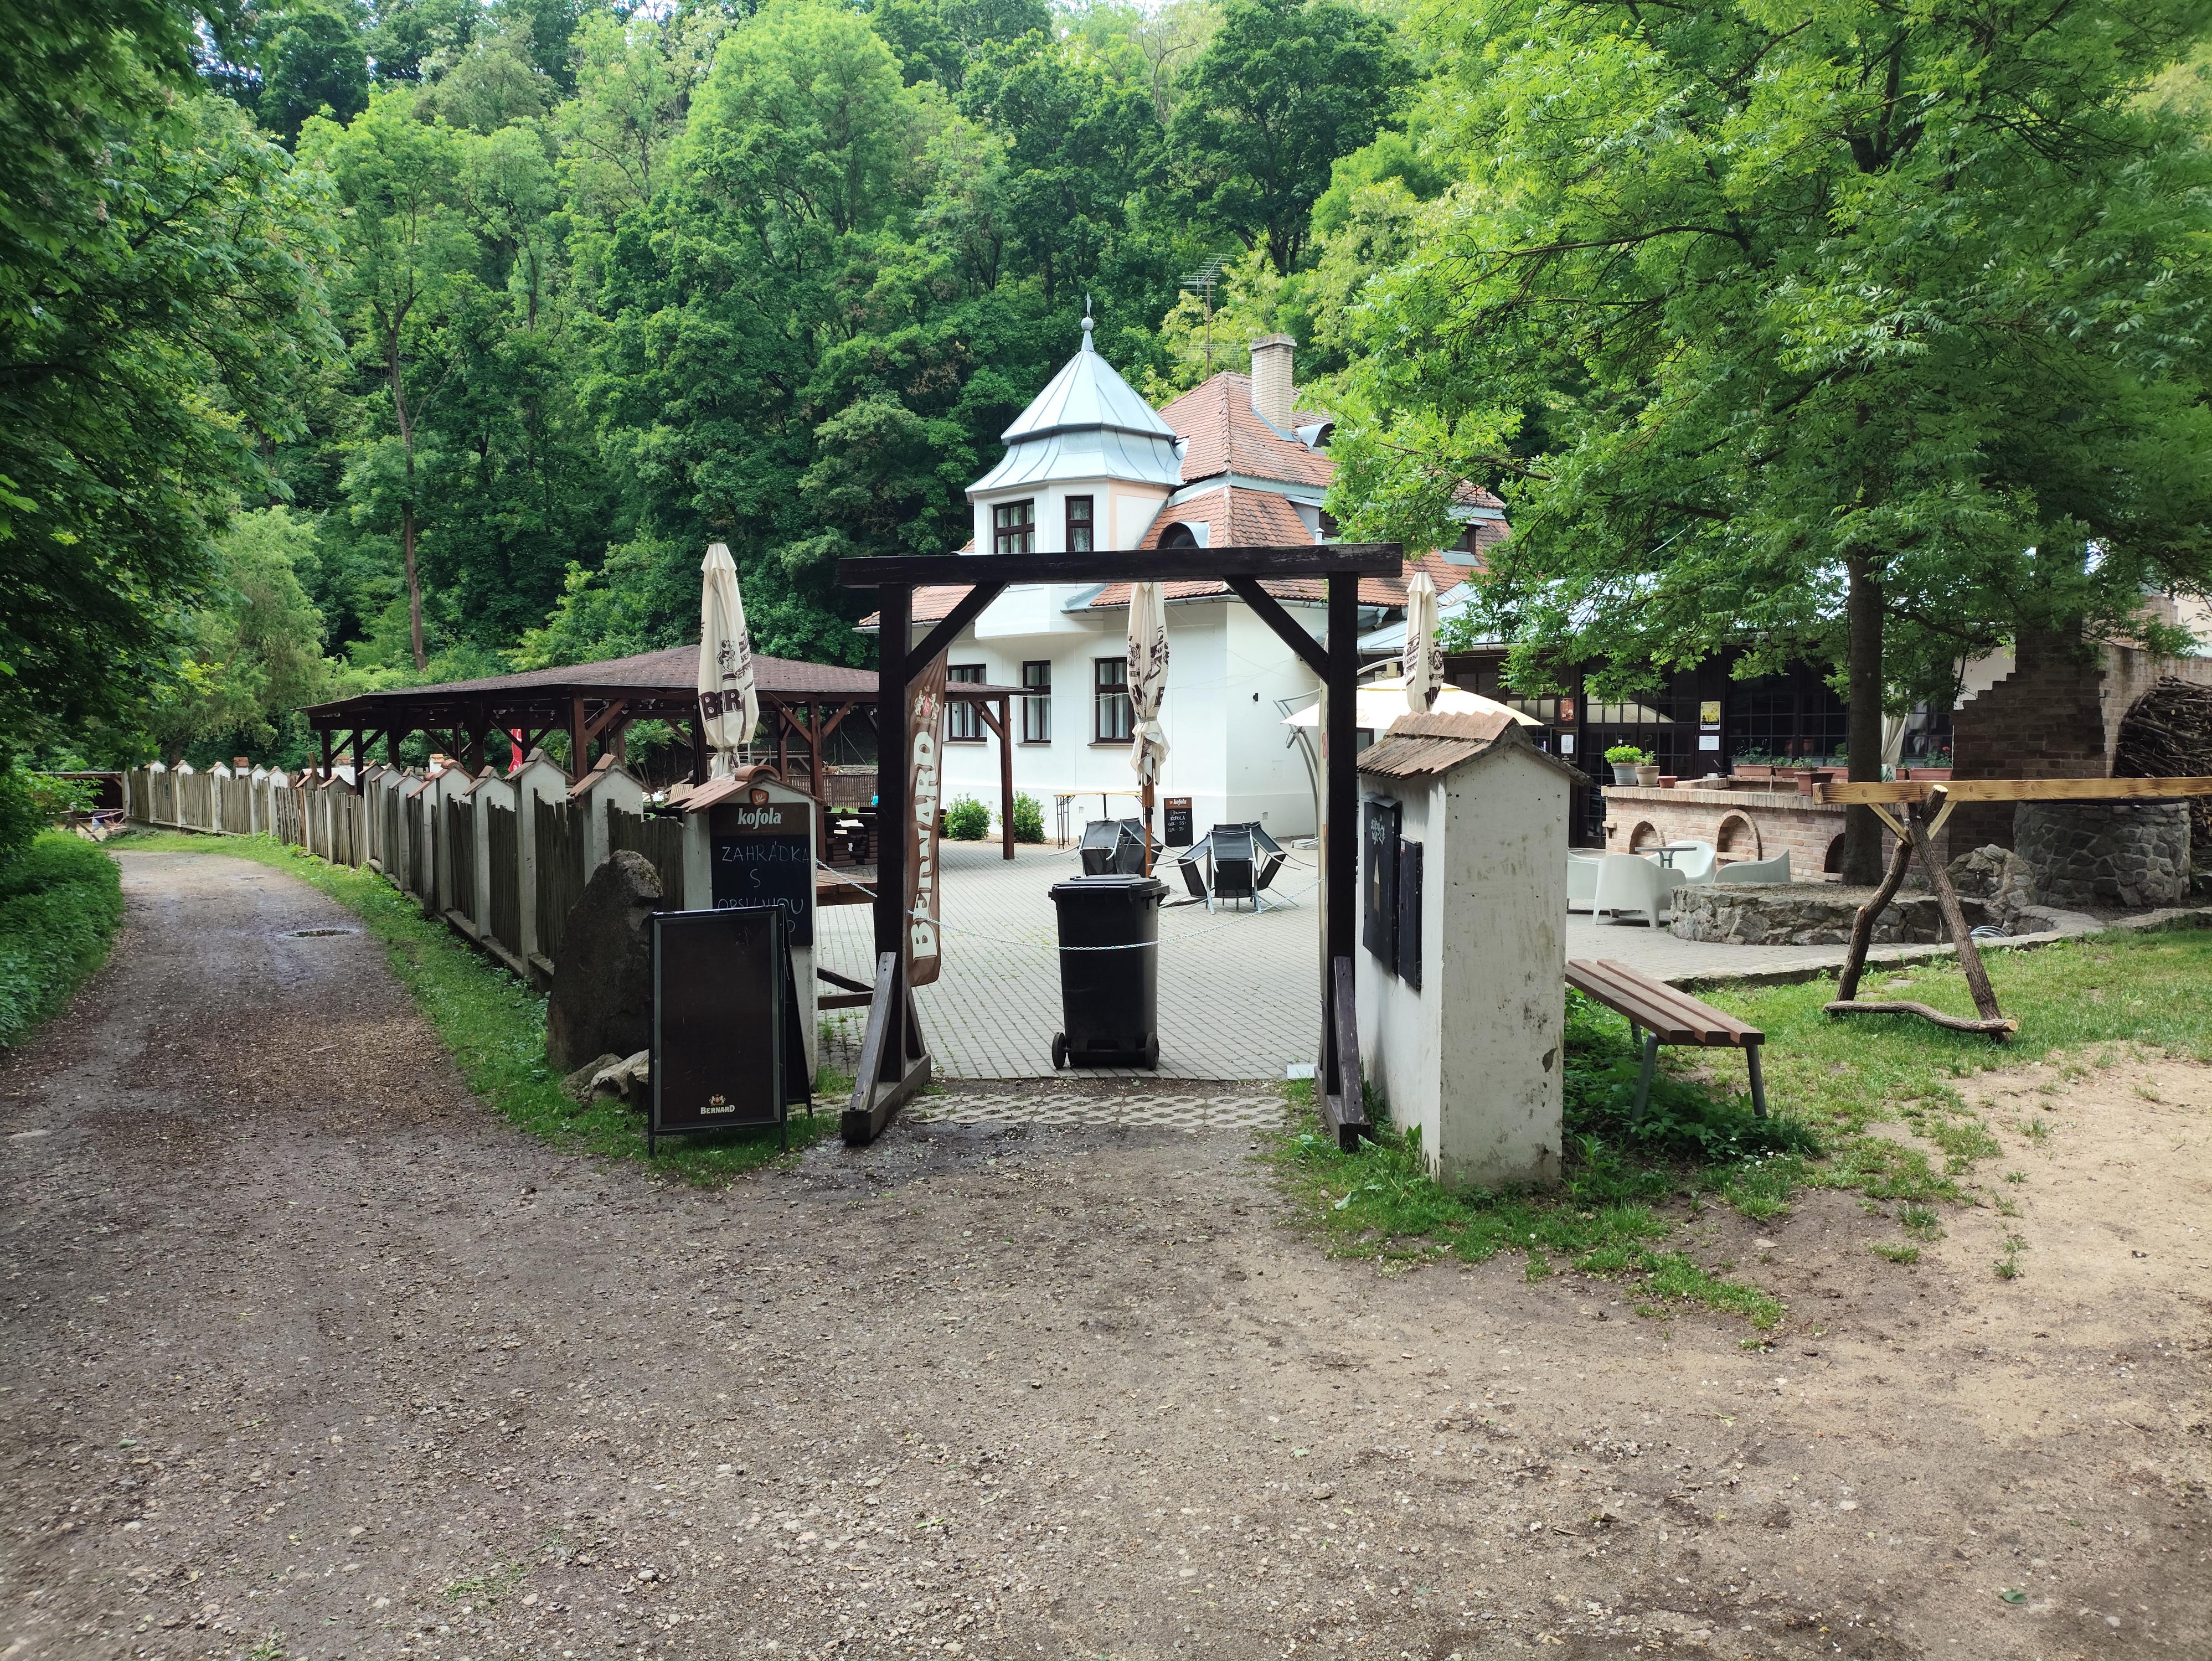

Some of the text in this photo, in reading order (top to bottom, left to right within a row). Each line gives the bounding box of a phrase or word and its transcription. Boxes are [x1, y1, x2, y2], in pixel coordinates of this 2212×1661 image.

[738, 807, 782, 829] kofola
[721, 840, 809, 865] ZAHRÁDKA
[911, 731, 939, 960] BERNARD
[750, 869, 761, 888] S
[700, 1105, 735, 1115] BERNARD
